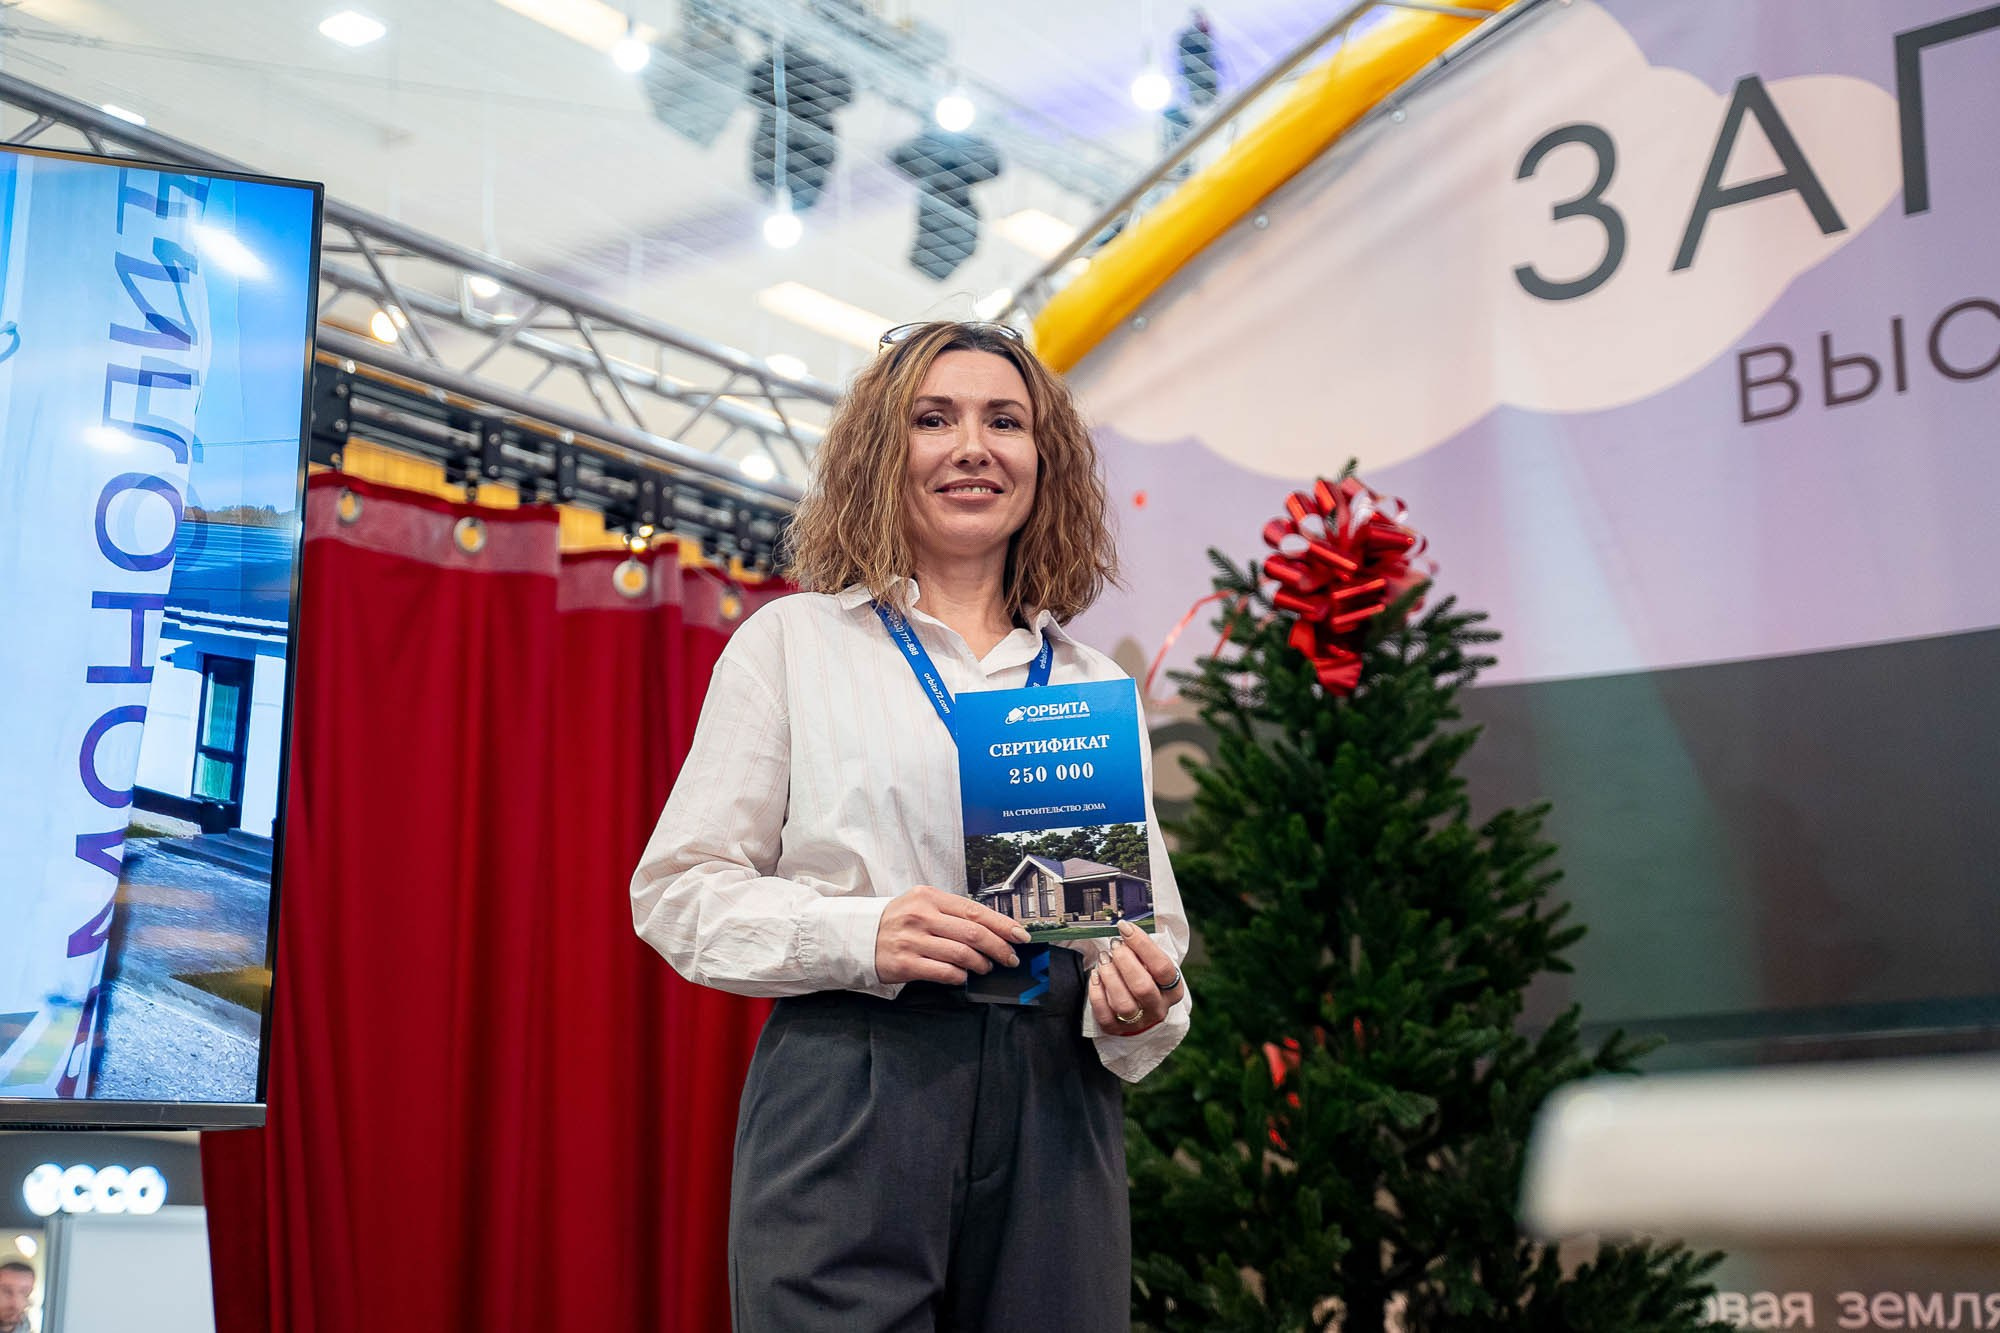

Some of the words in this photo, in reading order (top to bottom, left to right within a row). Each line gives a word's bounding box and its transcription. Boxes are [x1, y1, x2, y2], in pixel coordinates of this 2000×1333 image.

[924, 672, 950, 714] orbita72.com
[1026, 700, 1090, 717] ОРБИТА
[989, 734, 1110, 757] СЕРТИФИКАТ
[1009, 766, 1048, 785] 250
[1055, 762, 1094, 781] 000
[1002, 810, 1015, 818] НА
[1015, 804, 1082, 817] СТРОИТЕЛЬСТВО
[1082, 802, 1107, 812] ДОМА
